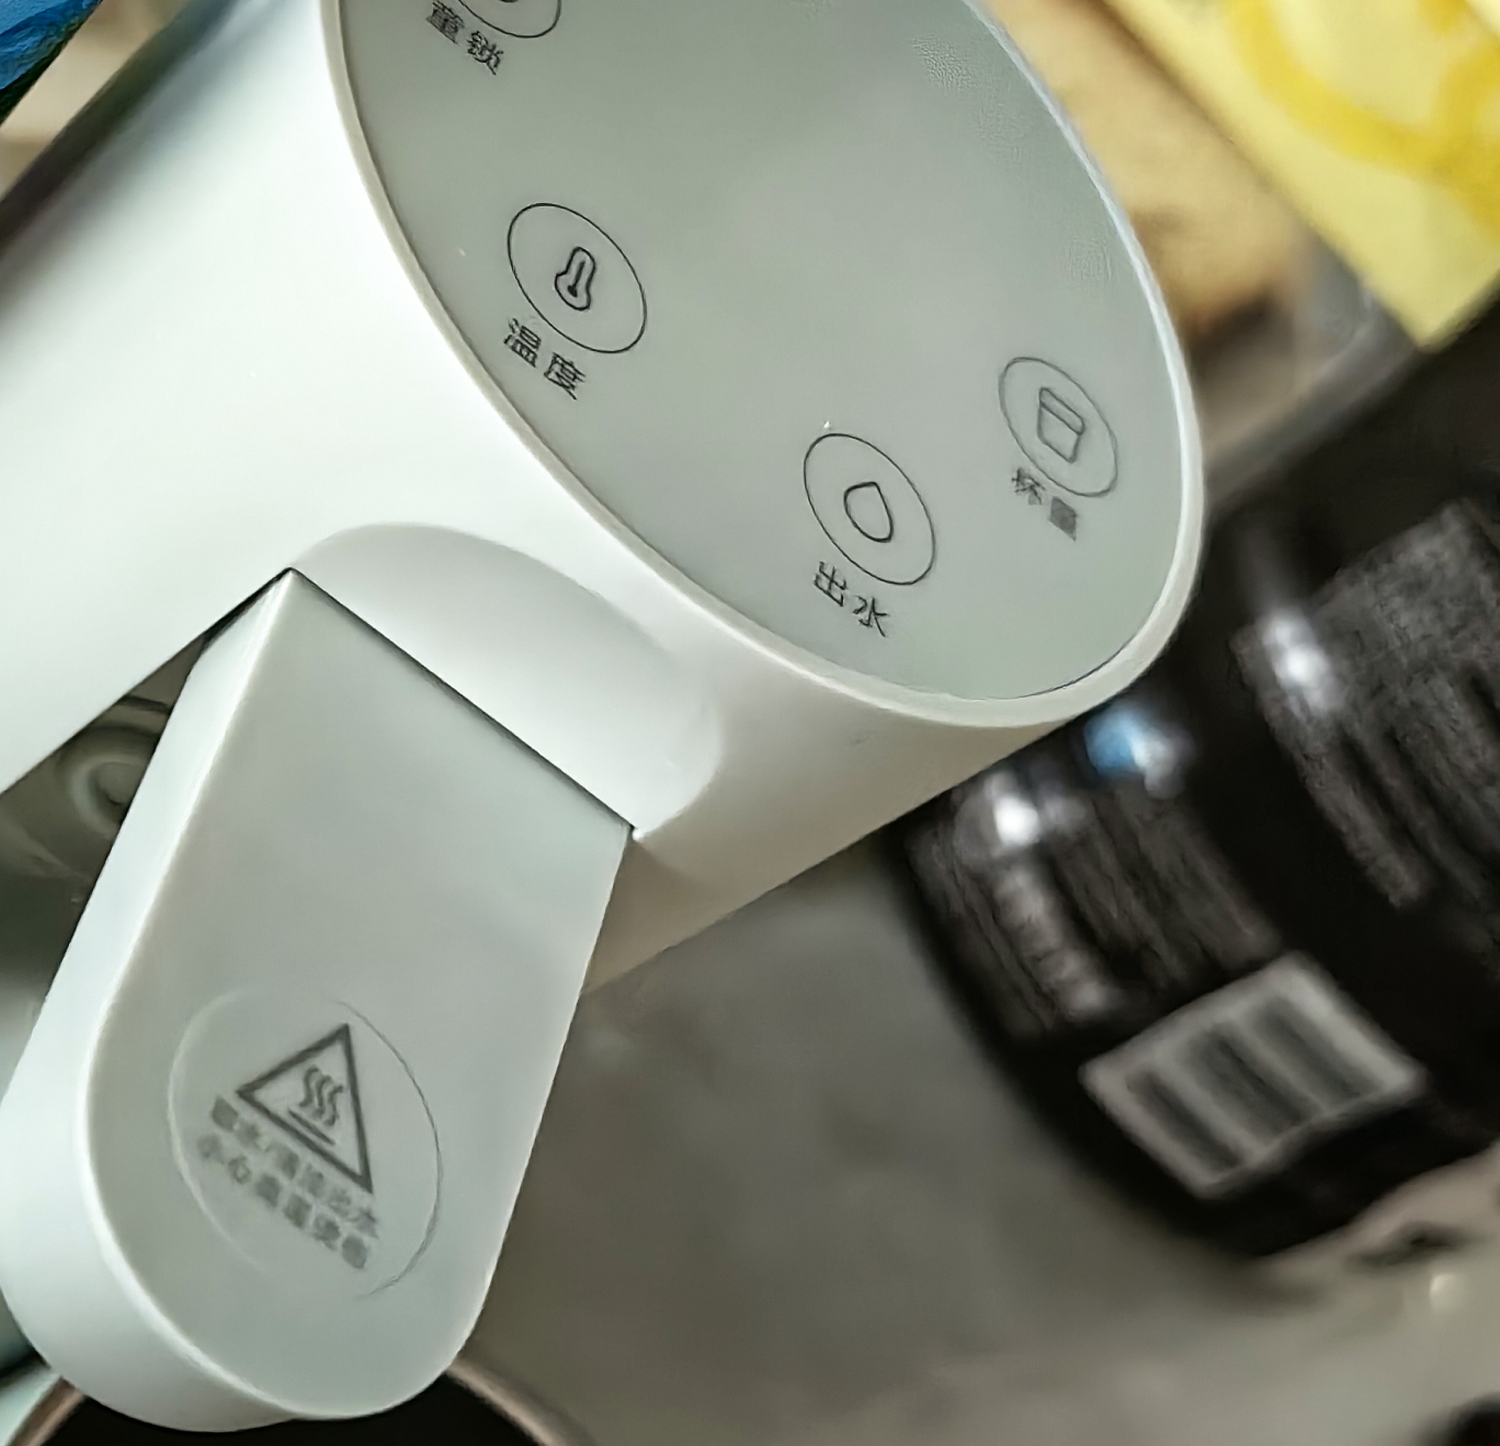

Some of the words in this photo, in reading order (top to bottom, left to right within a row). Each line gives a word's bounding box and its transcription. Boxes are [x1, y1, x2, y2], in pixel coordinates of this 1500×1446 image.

[426, 0, 503, 75] 童锁
[504, 317, 585, 400] 温度
[814, 562, 889, 638] 出水
